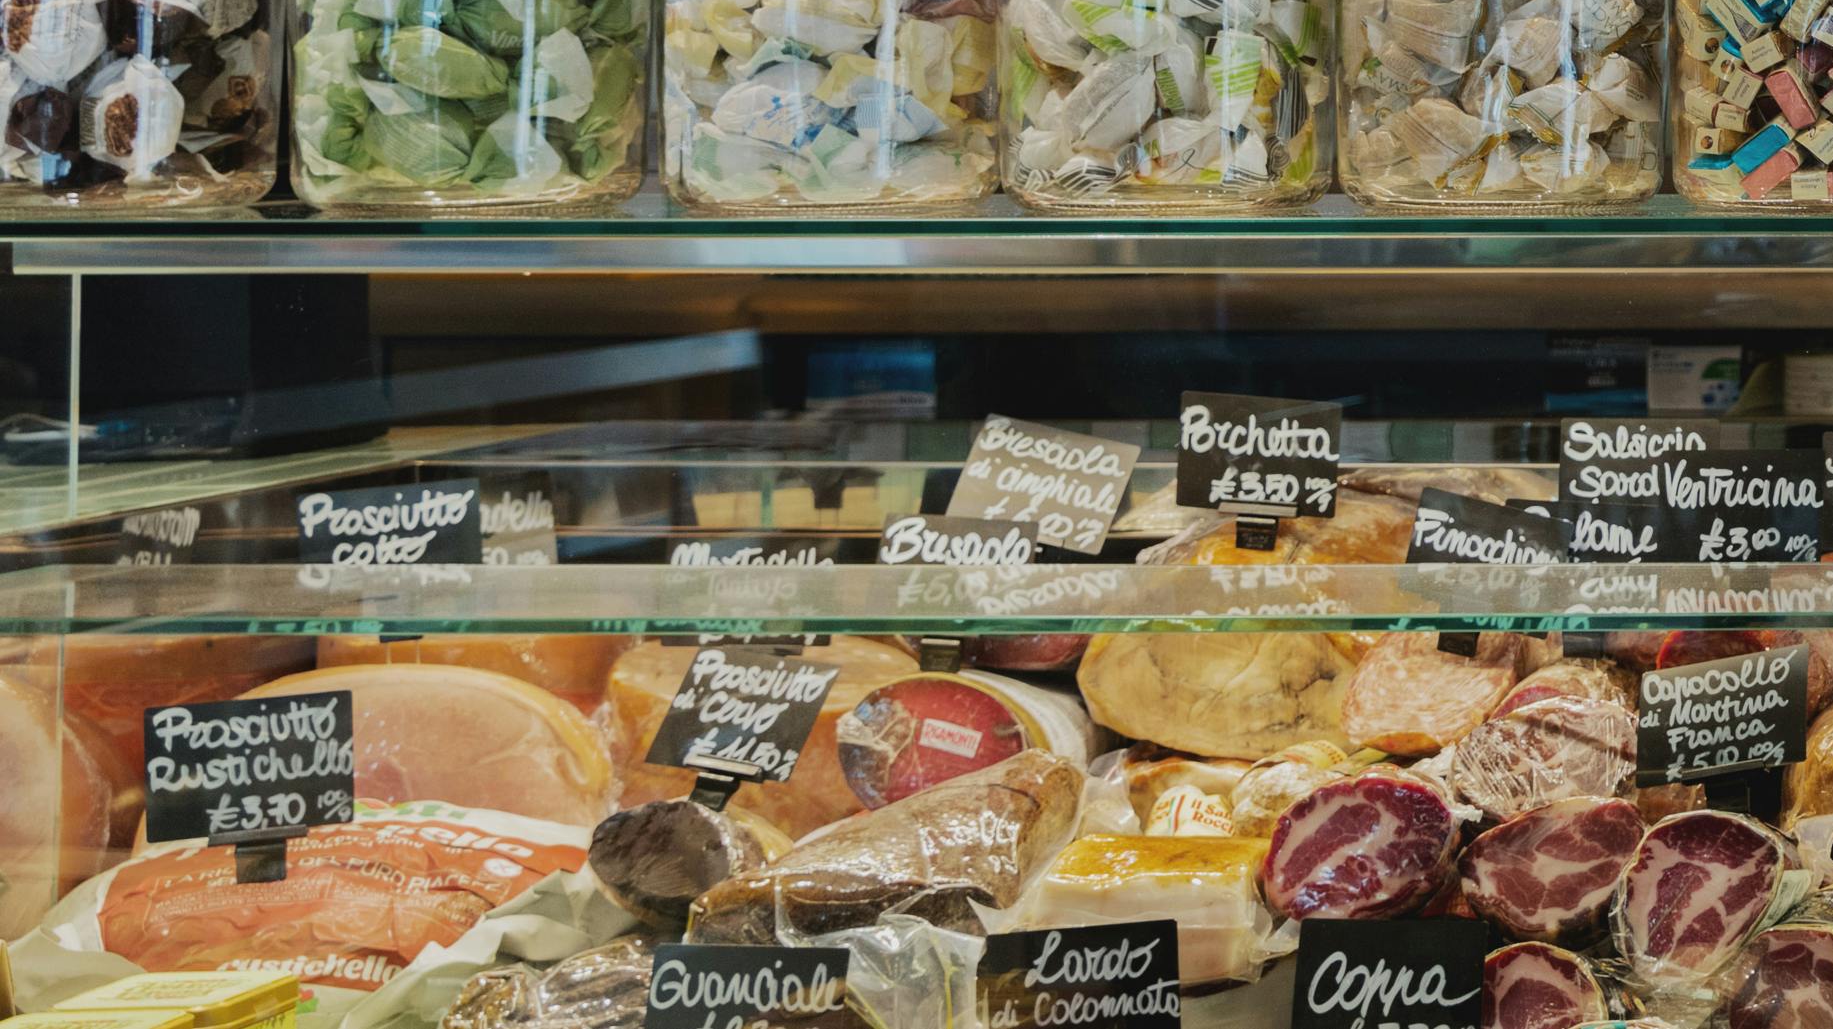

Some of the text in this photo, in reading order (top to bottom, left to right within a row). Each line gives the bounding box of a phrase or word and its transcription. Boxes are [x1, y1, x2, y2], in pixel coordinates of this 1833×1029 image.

[979, 419, 1126, 477] Bresaola
[1180, 403, 1340, 461] Porchetta
[969, 457, 1118, 517] di cinghiale
[1664, 457, 1823, 508] Ventricina
[300, 488, 477, 539] Prosciutto
[881, 517, 1042, 564] Bresaola
[332, 528, 435, 566] cotto
[694, 649, 839, 703] Prosciutto
[1643, 650, 1796, 704] Capocollo
[153, 698, 338, 751] Prosciutto
[1641, 690, 1788, 727] di Martina
[1666, 720, 1774, 753] Franca
[149, 738, 354, 792] Rustichello
[1024, 931, 1157, 988] Lardo
[1307, 951, 1480, 1012] Coppa
[649, 959, 847, 1015] Guanciale
[1034, 979, 1180, 1027] Colonnata
